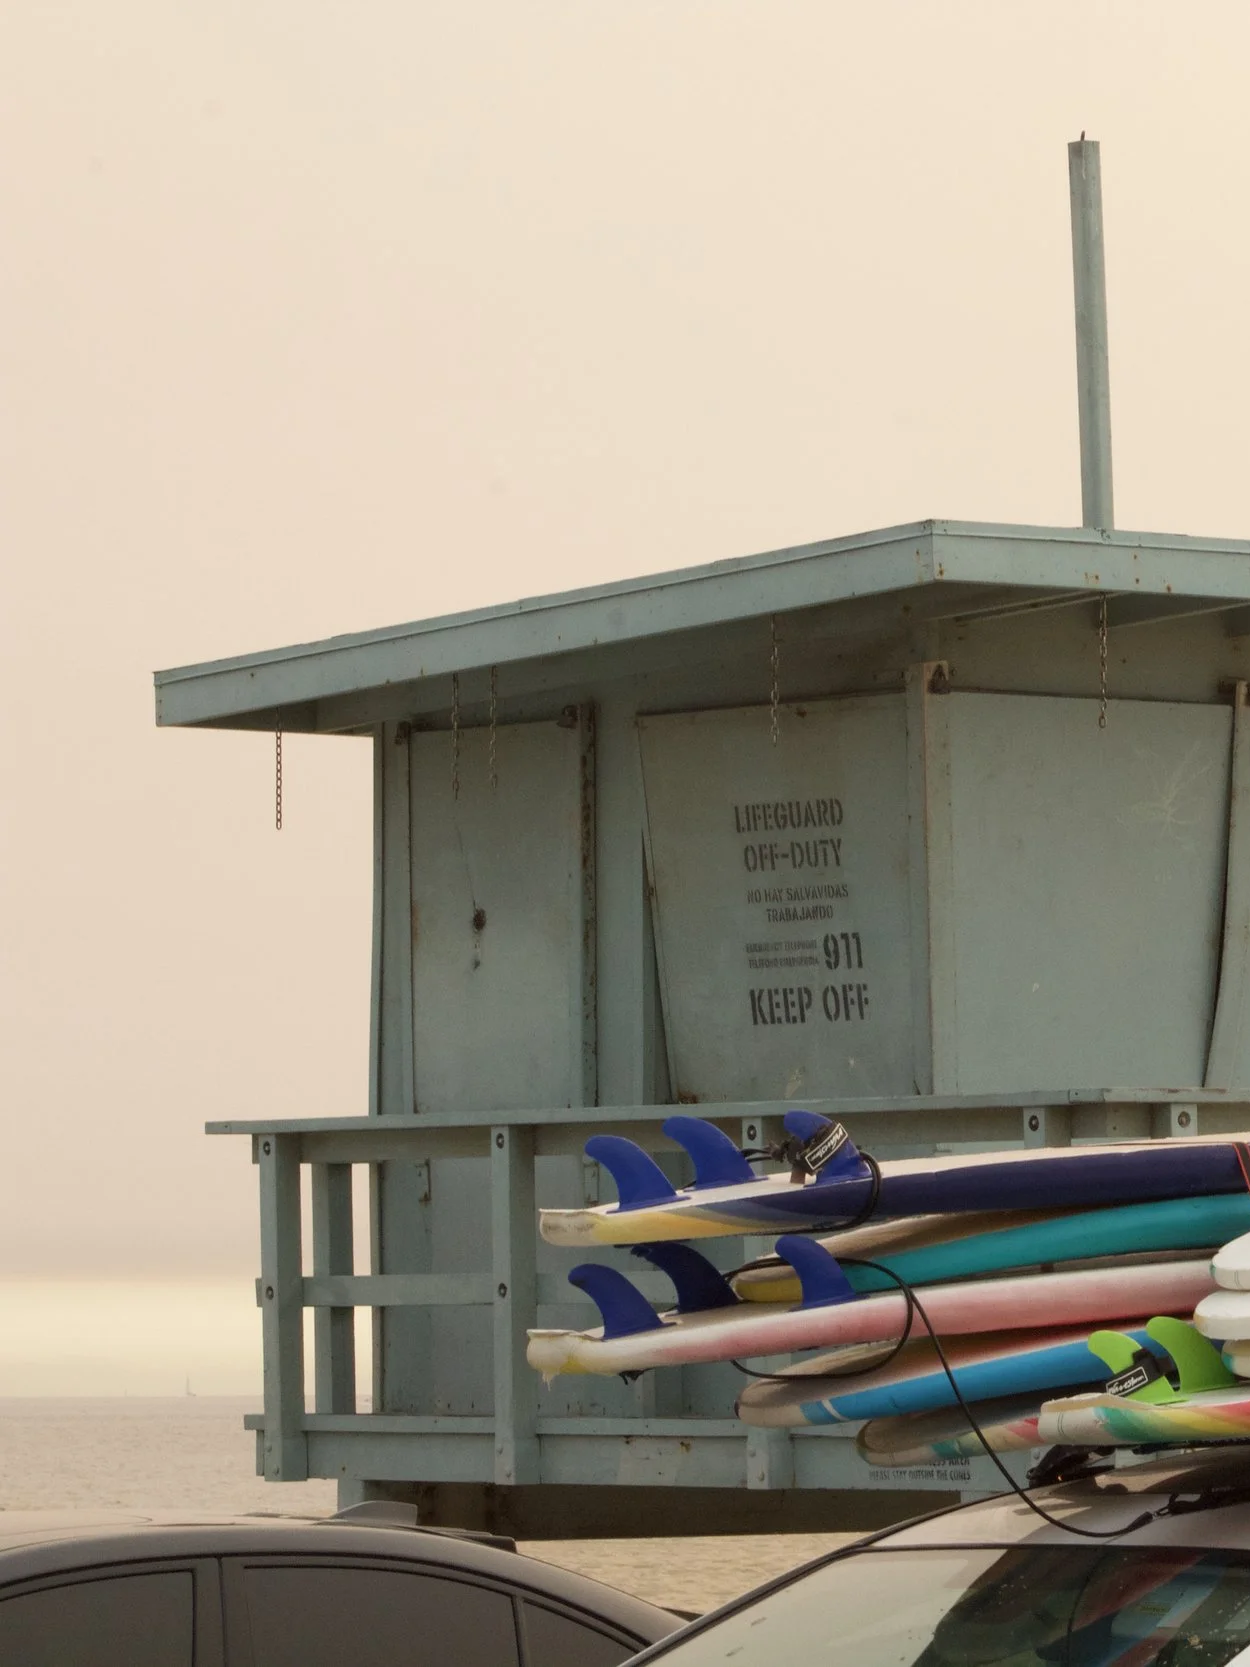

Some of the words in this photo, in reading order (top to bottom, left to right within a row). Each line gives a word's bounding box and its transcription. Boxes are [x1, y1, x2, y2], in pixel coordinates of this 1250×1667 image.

[734, 798, 844, 833] LIFEGUARD
[743, 838, 842, 872] OFF-DUTY
[747, 888, 762, 904] NO
[764, 887, 783, 903] HAY
[787, 884, 849, 901] SALVAVIDAS
[766, 905, 834, 923] TRABAJANDO
[823, 932, 864, 970] 911
[750, 986, 813, 1025] KEEP
[822, 983, 869, 1022] OFF
